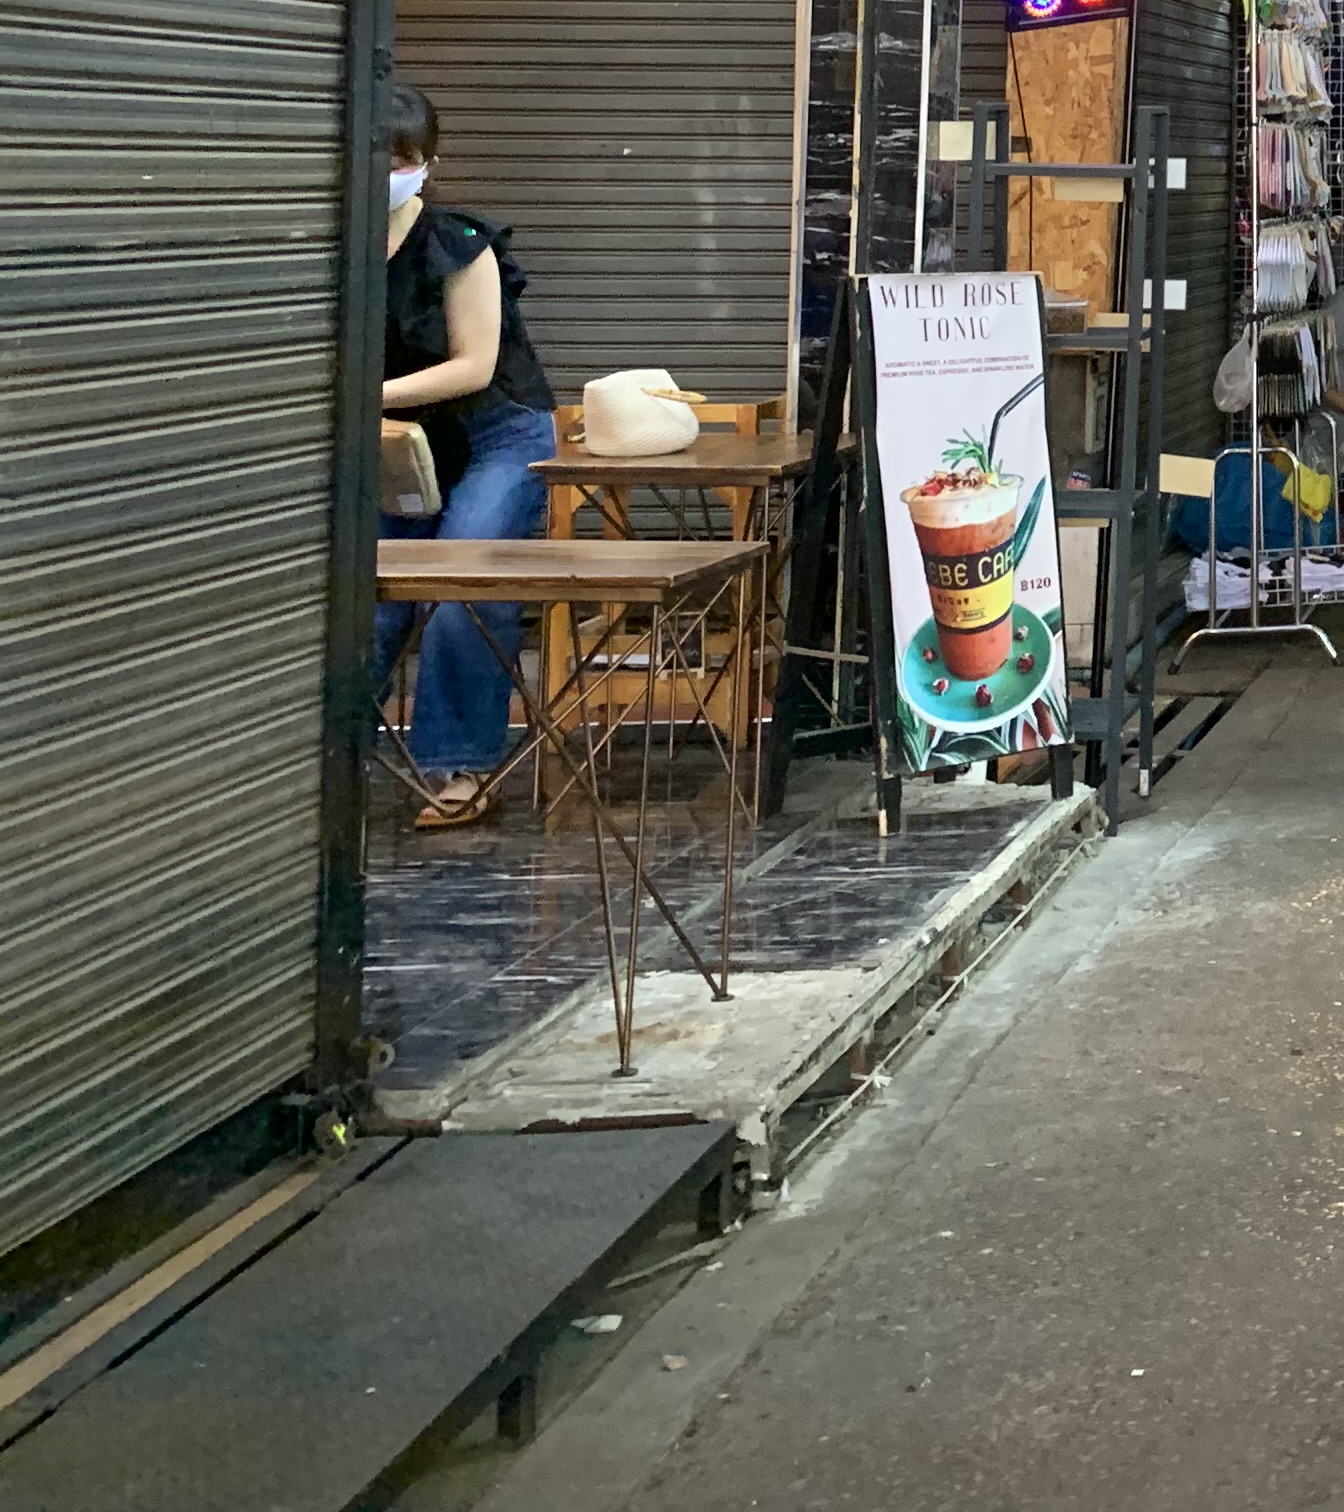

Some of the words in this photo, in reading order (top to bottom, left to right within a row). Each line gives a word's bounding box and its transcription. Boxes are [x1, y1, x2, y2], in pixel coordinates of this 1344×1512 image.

[880, 283, 945, 309] WILD
[963, 281, 1024, 307] ROSE
[918, 315, 991, 342] TONIC
